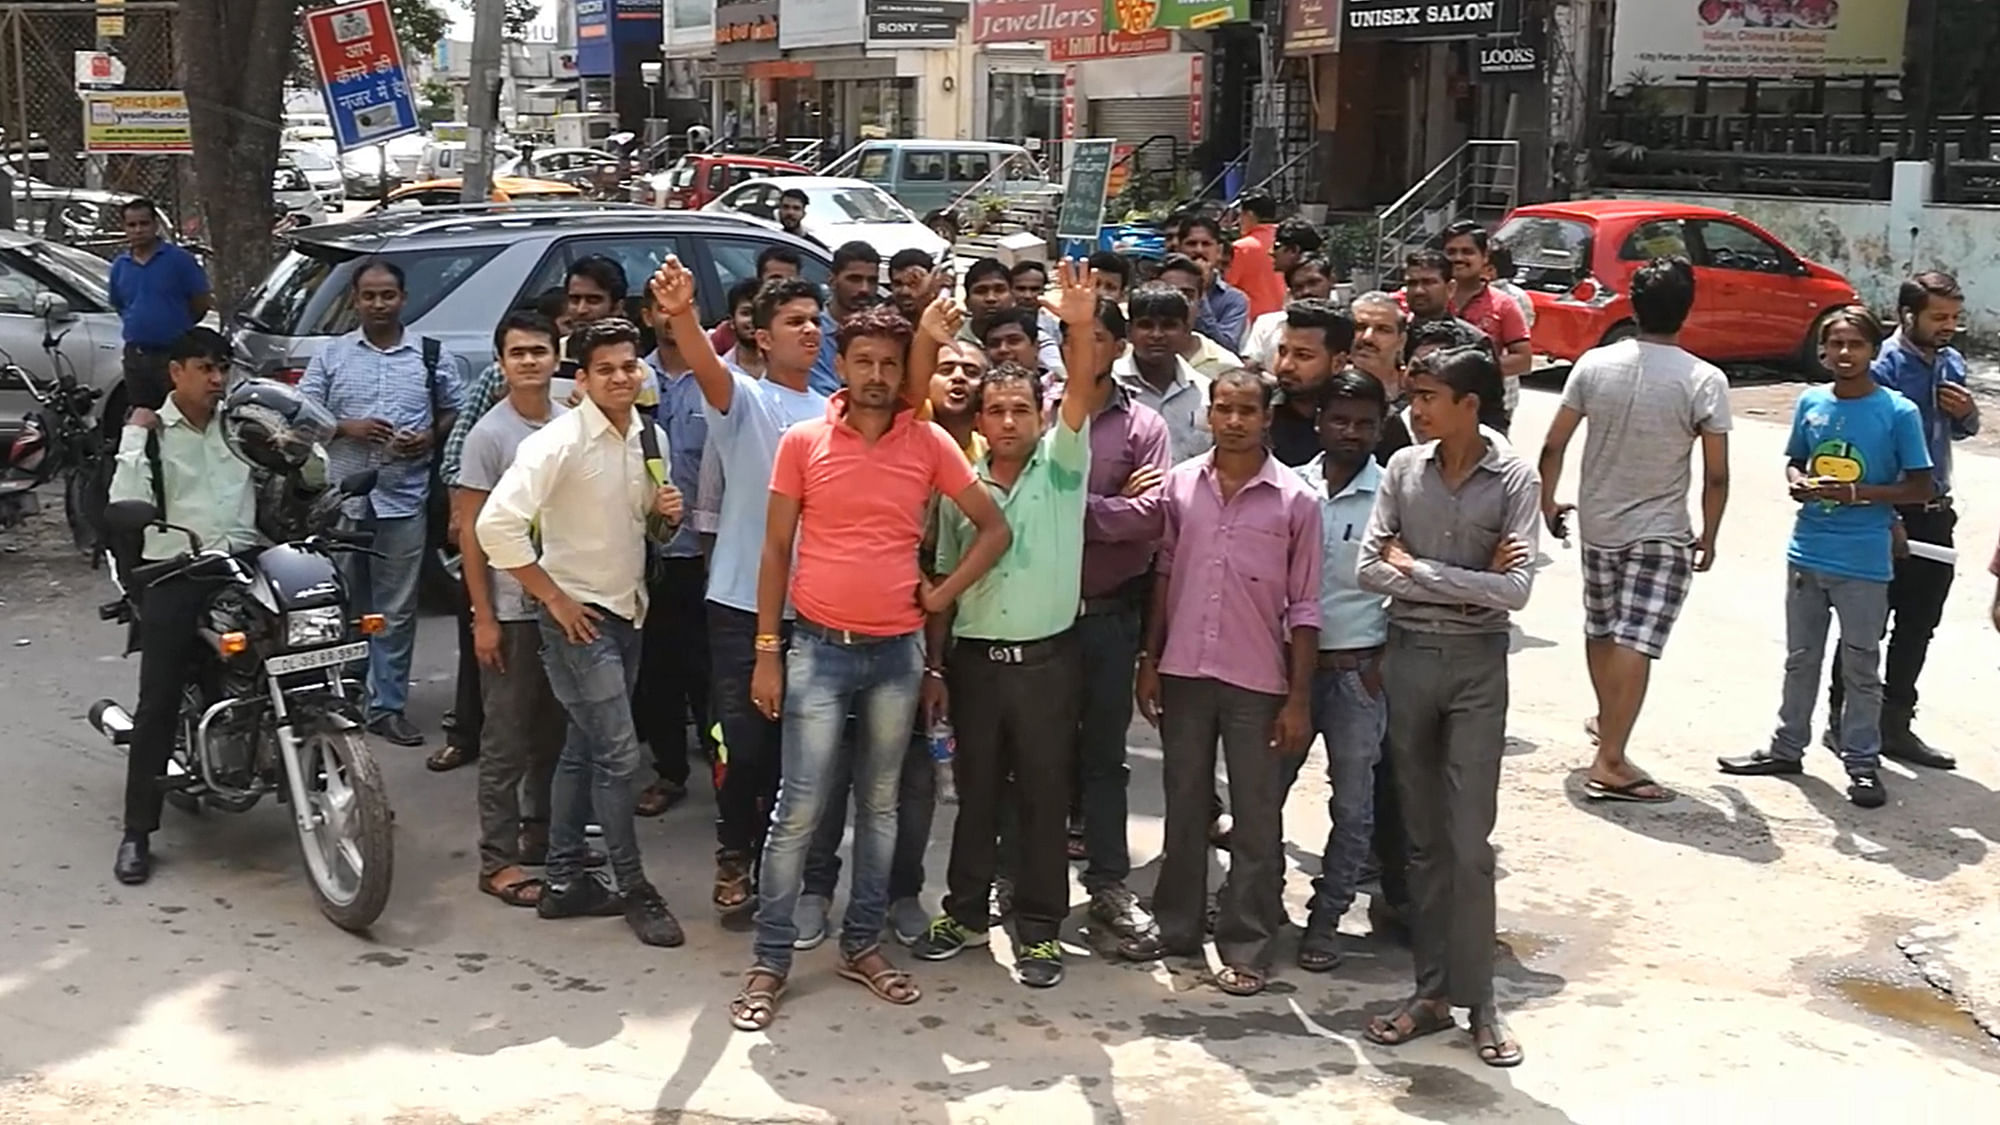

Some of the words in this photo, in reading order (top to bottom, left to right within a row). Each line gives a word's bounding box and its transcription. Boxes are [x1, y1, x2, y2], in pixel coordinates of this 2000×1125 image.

[976, 3, 1098, 39] Jewellers
[1350, 7, 1420, 27] UNISEX
[1426, 2, 1494, 22] SALON
[878, 22, 918, 33] SONY
[345, 41, 373, 59] आप
[1481, 48, 1535, 64] LOOKS
[373, 54, 395, 74] की
[376, 79, 390, 100] में
